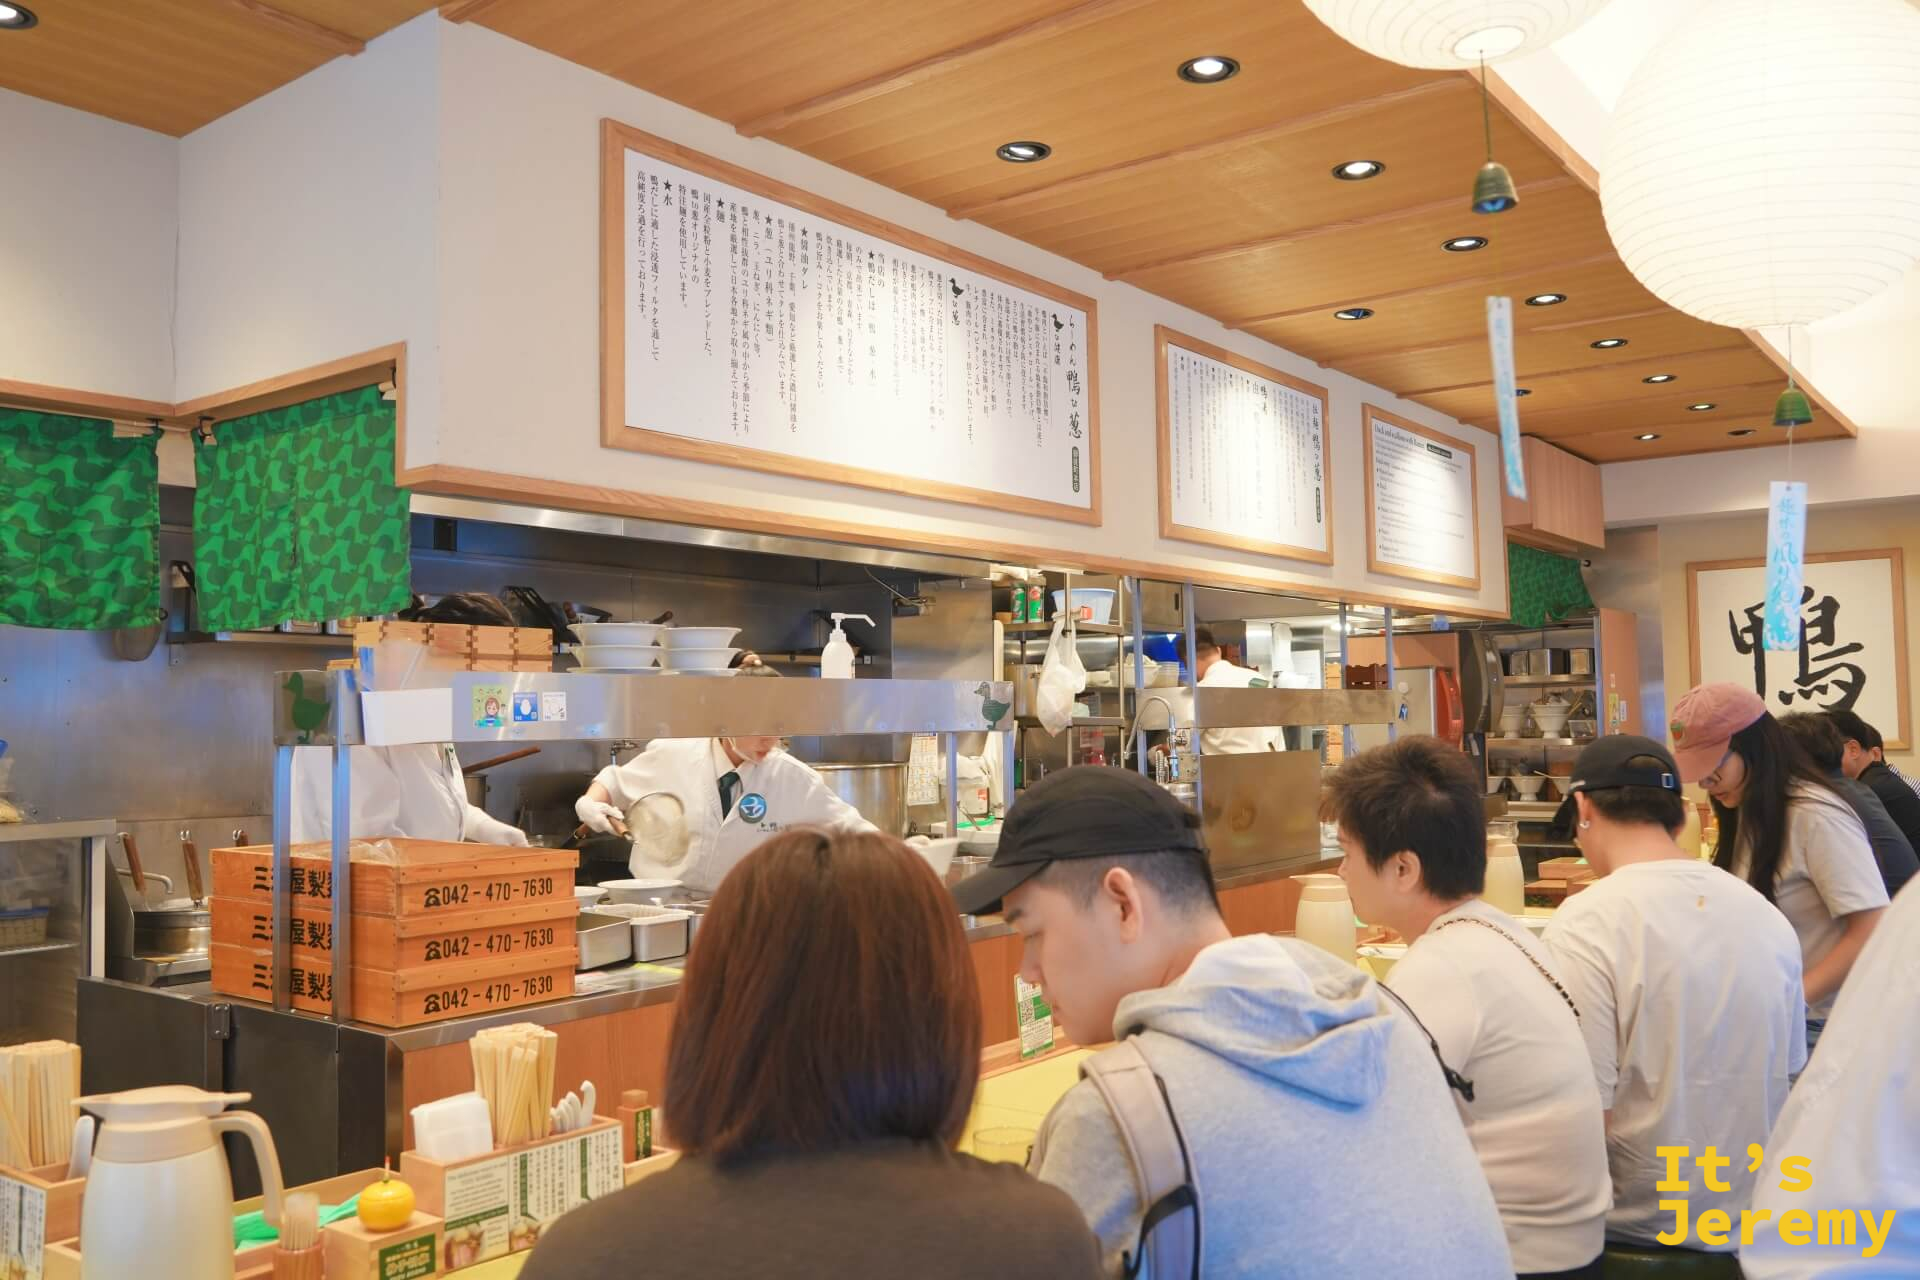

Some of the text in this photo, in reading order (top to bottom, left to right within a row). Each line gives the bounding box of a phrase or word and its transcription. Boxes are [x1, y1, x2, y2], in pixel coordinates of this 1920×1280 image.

[252, 865, 332, 898] 三屋製
[442, 877, 554, 906] 042-470-7630
[252, 915, 332, 951] 三屋製
[443, 927, 554, 959] 042-470-7630
[252, 963, 332, 1002] 三屋製
[442, 975, 554, 1011] 042-470-7630
